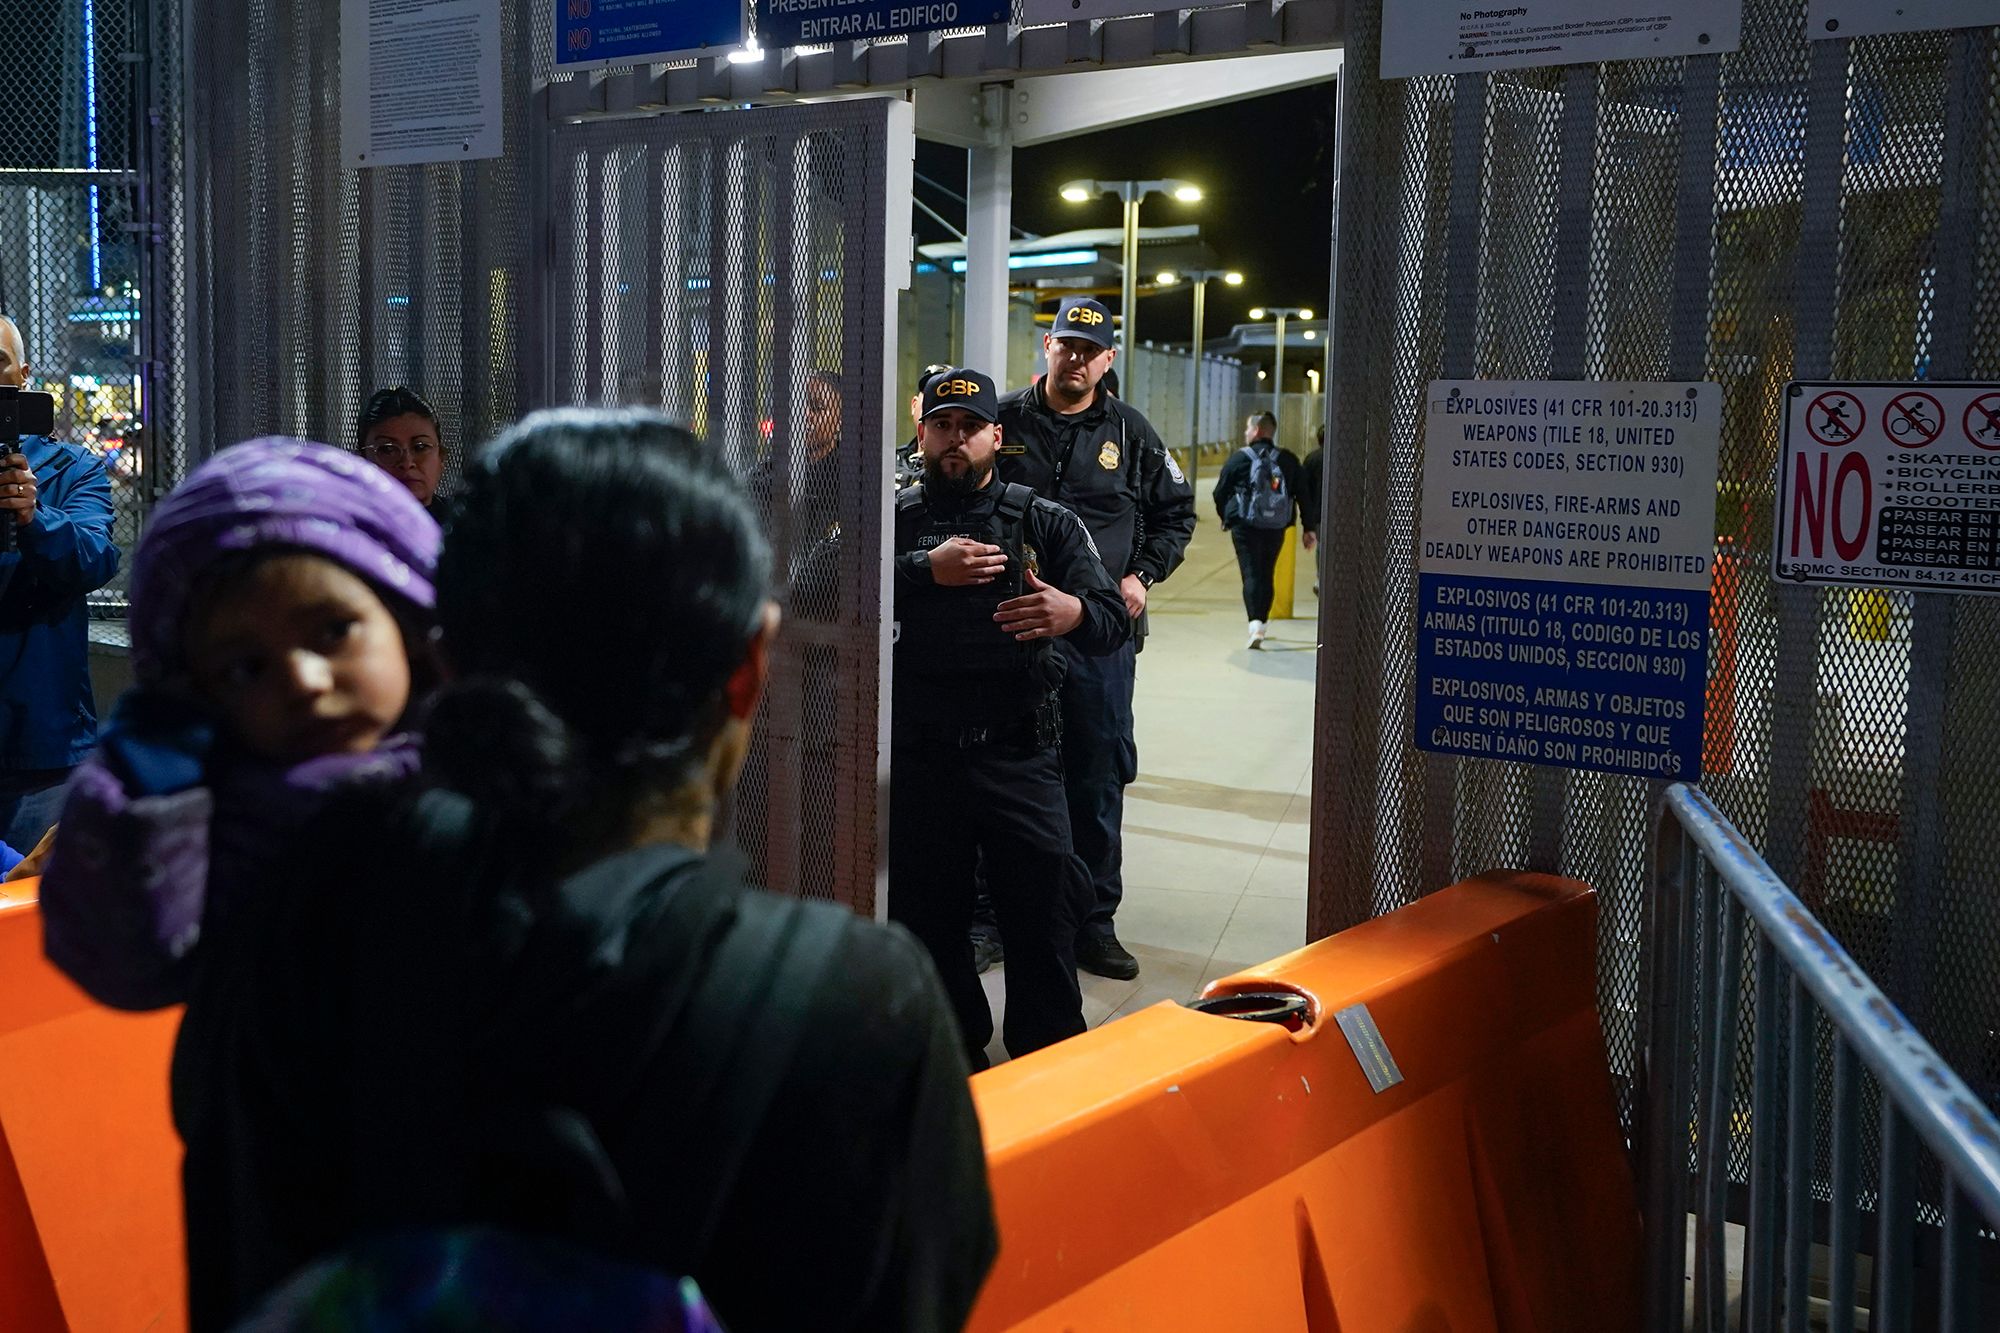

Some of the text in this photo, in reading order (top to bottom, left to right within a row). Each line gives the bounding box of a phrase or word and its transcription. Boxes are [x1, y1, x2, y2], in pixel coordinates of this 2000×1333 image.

[568, 0, 591, 21] NO
[801, 2, 958, 39] ENTRAR AL EDIFICIO
[1460, 7, 1528, 20] No Photography
[1585, 20, 1616, 28] Protection
[568, 27, 592, 51] NO
[1459, 40, 1492, 48] Photography
[1501, 36, 1534, 44] videography
[1541, 33, 1570, 41] prohibited
[1605, 26, 1645, 34] authorization
[1495, 49, 1517, 57] subject
[1525, 46, 1562, 55] prosecution.
[1067, 307, 1104, 326] CBP
[936, 379, 980, 397] CBP
[1446, 398, 1697, 422] EXPLOSIVES (41 CFR 101-20.313)
[1463, 424, 1675, 447] WEAPONS (TILE 18, UNITED
[1452, 450, 1685, 478] STATES CODES, SECTION 930)
[1898, 453, 2000, 466] SKATEBO
[1898, 467, 2000, 480] BICYCLIN
[1897, 481, 2000, 495] ROLLERB
[1452, 491, 1681, 517] EXPLOSIVES, FIRE-ARMS AND
[1791, 451, 1872, 561] NO
[1896, 495, 2000, 509] SCOOTER
[1893, 510, 1992, 524] PASEAR EN
[918, 534, 969, 547] FERNA
[1467, 518, 1661, 544] OTHER DANGEROUS AND
[1893, 524, 1991, 539] PASEAR EN
[1892, 538, 1990, 553] PASEAR EN
[1425, 541, 1706, 574] DEADLY WEAPONS ARE PROHIBITED
[1891, 551, 1989, 567] PASEAR EN
[1791, 563, 1835, 576] SDMC
[1840, 566, 1910, 579] SECTION
[1915, 570, 1956, 582] 84.12
[1437, 586, 1689, 626] EXPLOSIVOS (41 CFR 101-20.313)
[1424, 611, 1701, 650] ARMAS (TITULO 18, CODIGO DE LOS
[1434, 638, 1686, 681] ESTADOS UNIDOS, SECCION 930)
[1432, 677, 1686, 719] EXPLOSIVOS, ARMAS Y OBJETOS
[1443, 704, 1671, 745] QUE SON PELIGROSOS Y QUE
[1432, 726, 1682, 774] CAUSEN DAÑO SON PROHIBIDOS
